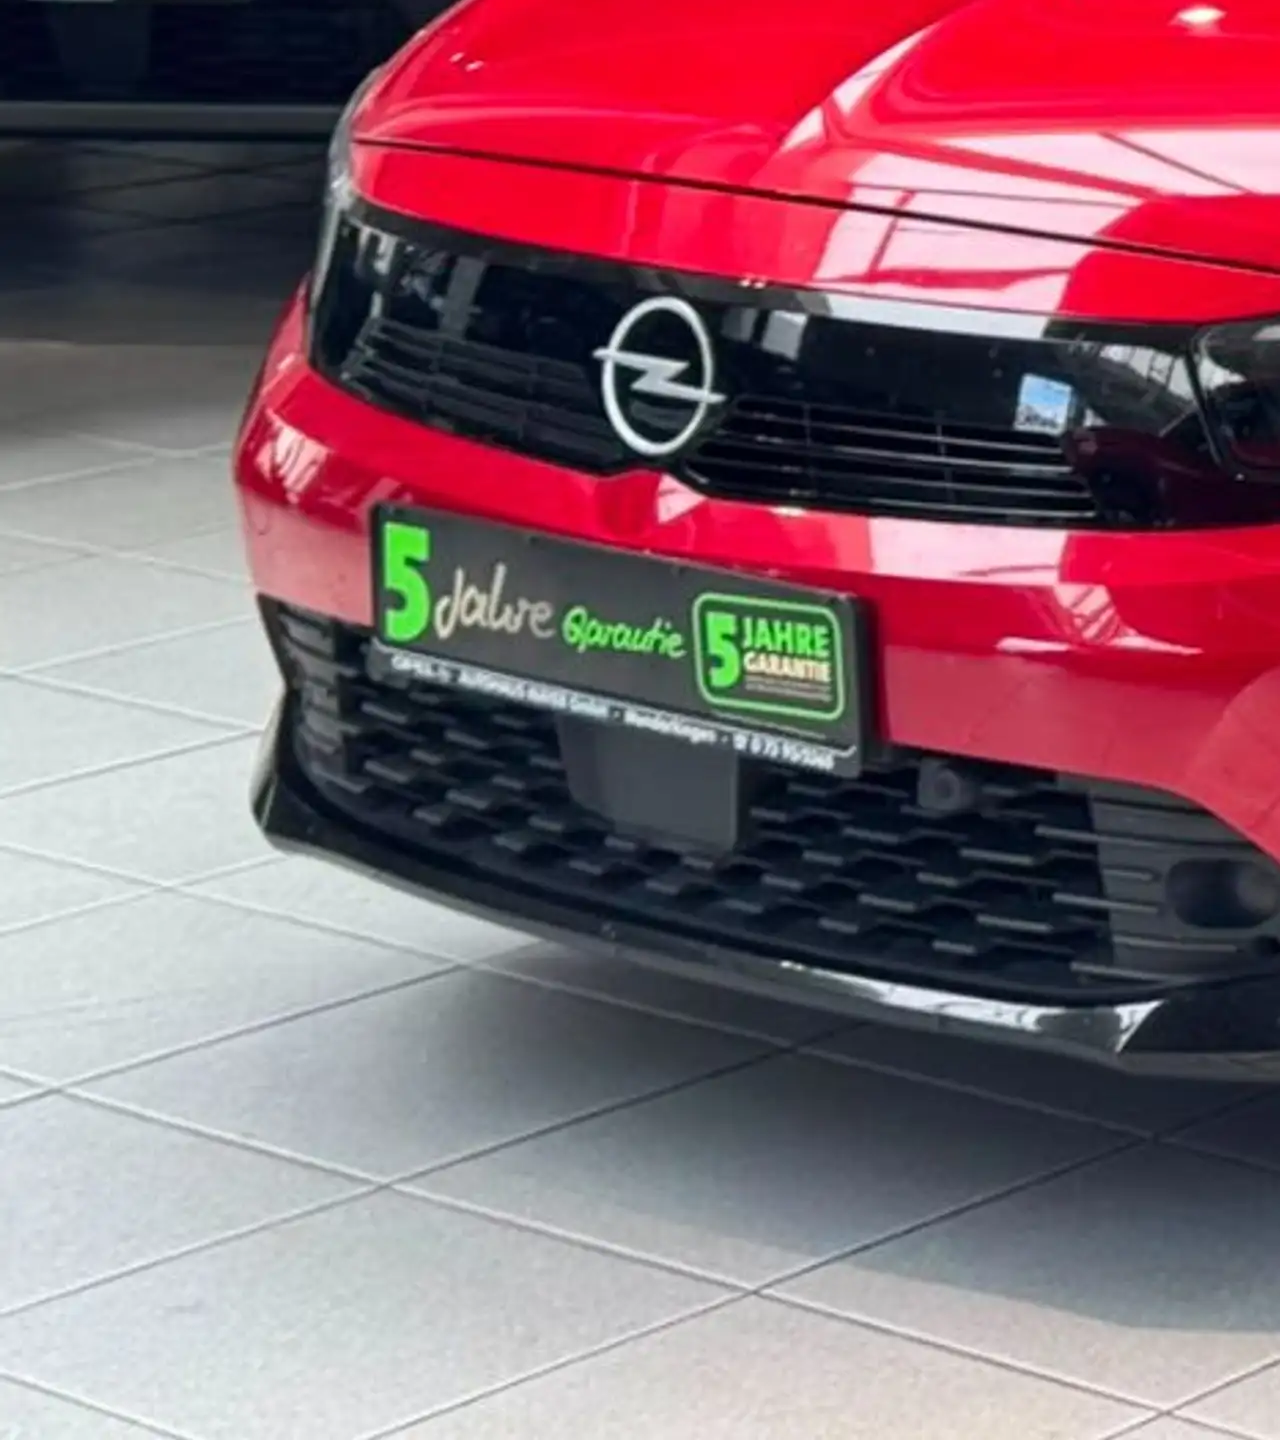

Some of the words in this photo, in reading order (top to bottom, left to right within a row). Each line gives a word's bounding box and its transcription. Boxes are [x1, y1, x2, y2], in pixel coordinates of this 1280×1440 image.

[384, 521, 430, 643] 5
[706, 612, 741, 688] 5
[743, 616, 829, 657] JAHRE
[743, 651, 831, 692] GARANTIE
